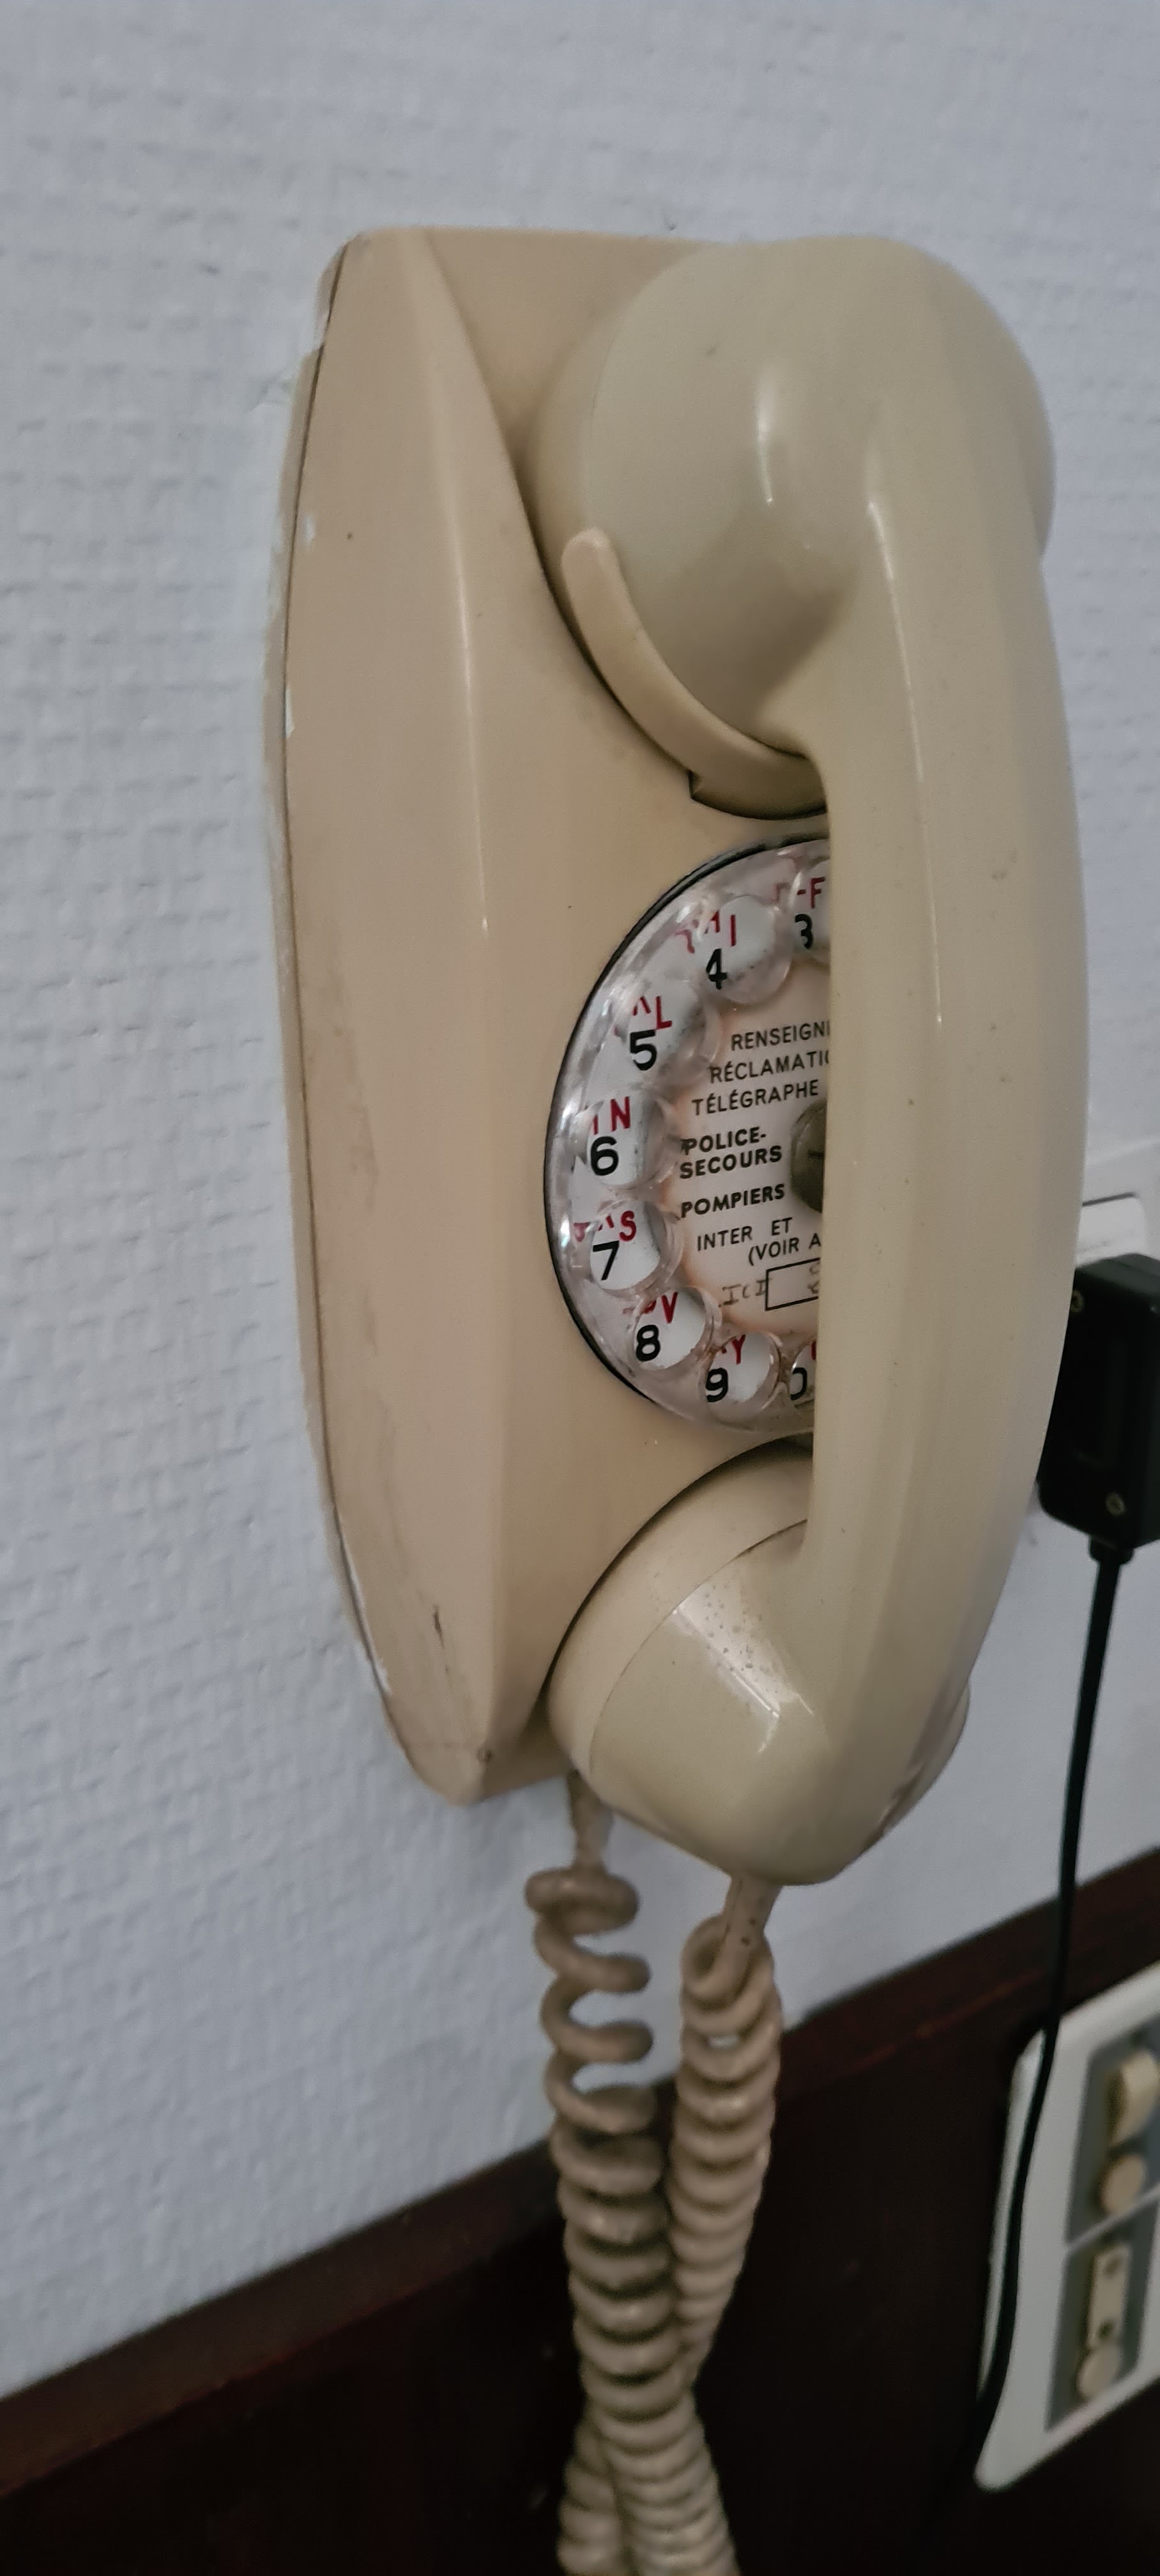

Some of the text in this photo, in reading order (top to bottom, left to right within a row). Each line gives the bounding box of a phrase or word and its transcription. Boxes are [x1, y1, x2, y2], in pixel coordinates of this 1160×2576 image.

[795, 914, 814, 950] 3
[705, 948, 728, 990] 4
[630, 1029, 657, 1071] 5
[691, 1079, 819, 1116] TÉLÉGRAPHE
[590, 1136, 619, 1176] 6
[681, 1126, 767, 1156] POLICE-
[680, 1145, 782, 1179] SECOURS
[681, 1183, 785, 1218] POMPIERS
[697, 1217, 793, 1252] INTER ET
[748, 1237, 800, 1266] (VOIR
[593, 1240, 620, 1281] 7
[636, 1324, 661, 1361] 8
[706, 1367, 728, 1402] 9
